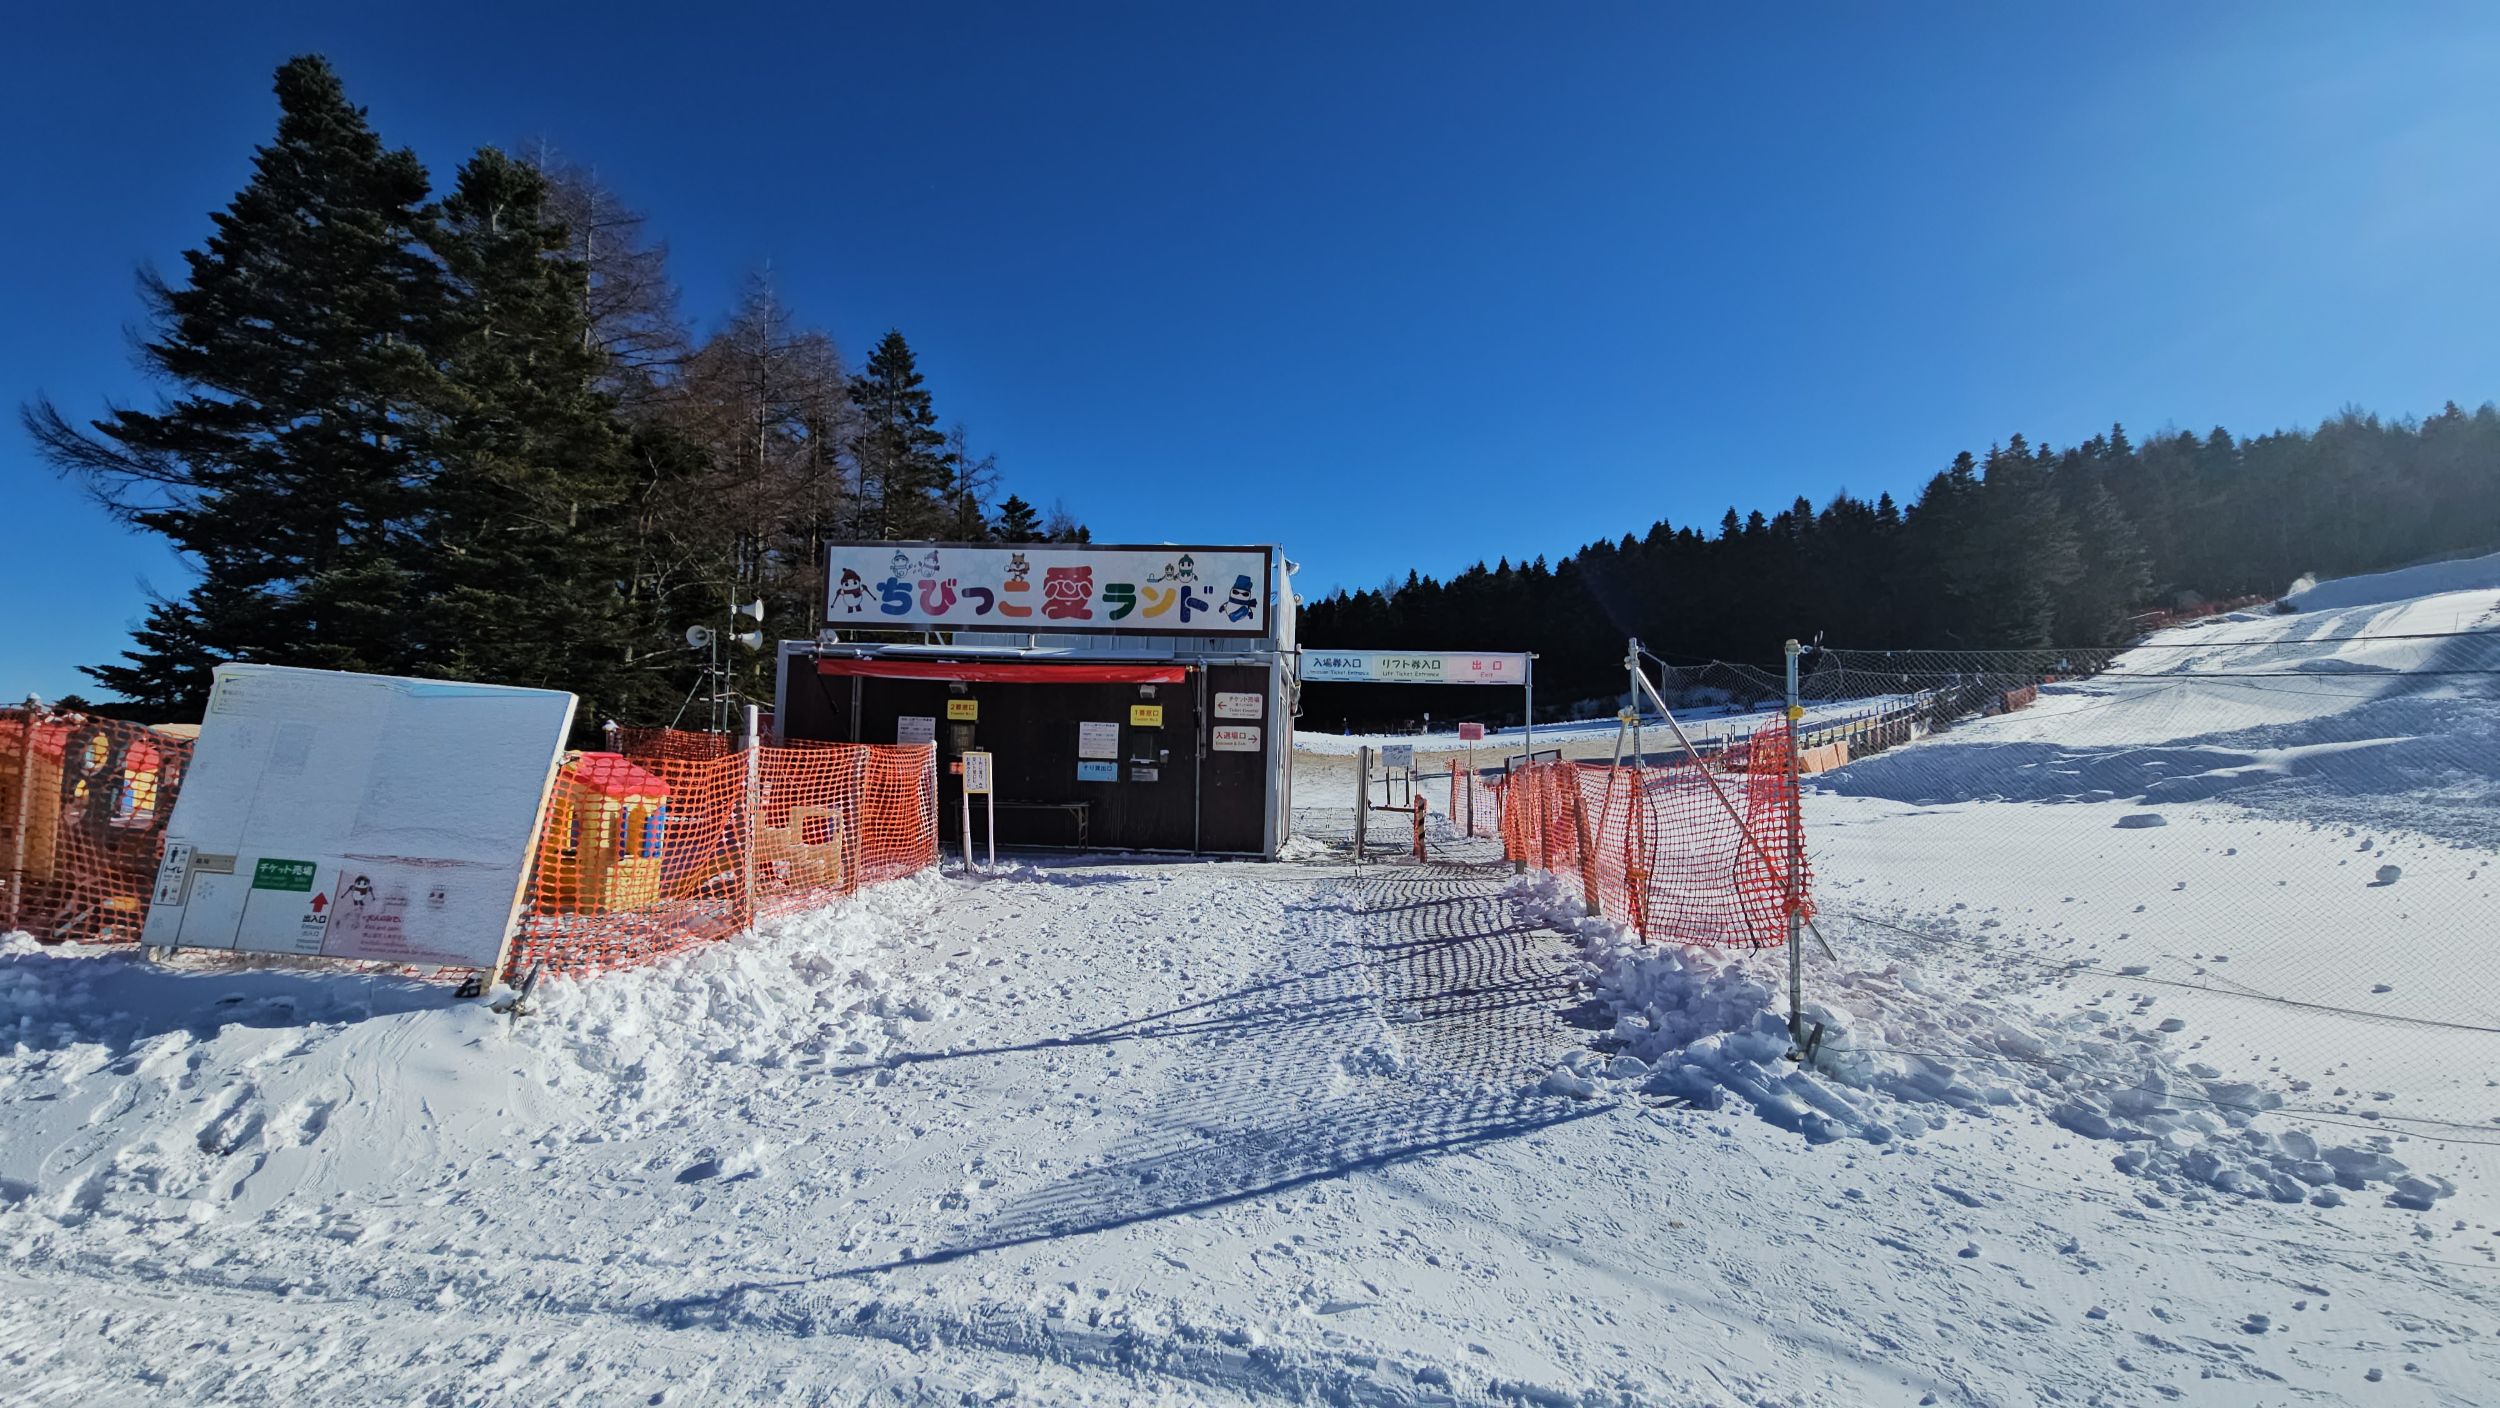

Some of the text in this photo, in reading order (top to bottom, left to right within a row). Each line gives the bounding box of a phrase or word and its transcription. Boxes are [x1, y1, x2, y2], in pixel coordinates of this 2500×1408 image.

[876, 565, 1214, 622] ちびっこ愛ランド
[1313, 657, 1362, 668] 入場券入口
[1382, 657, 1441, 670] リフト券入口
[164, 865, 184, 874] トイレ
[259, 862, 314, 876] チケット売場
[302, 914, 327, 924] 出入口
